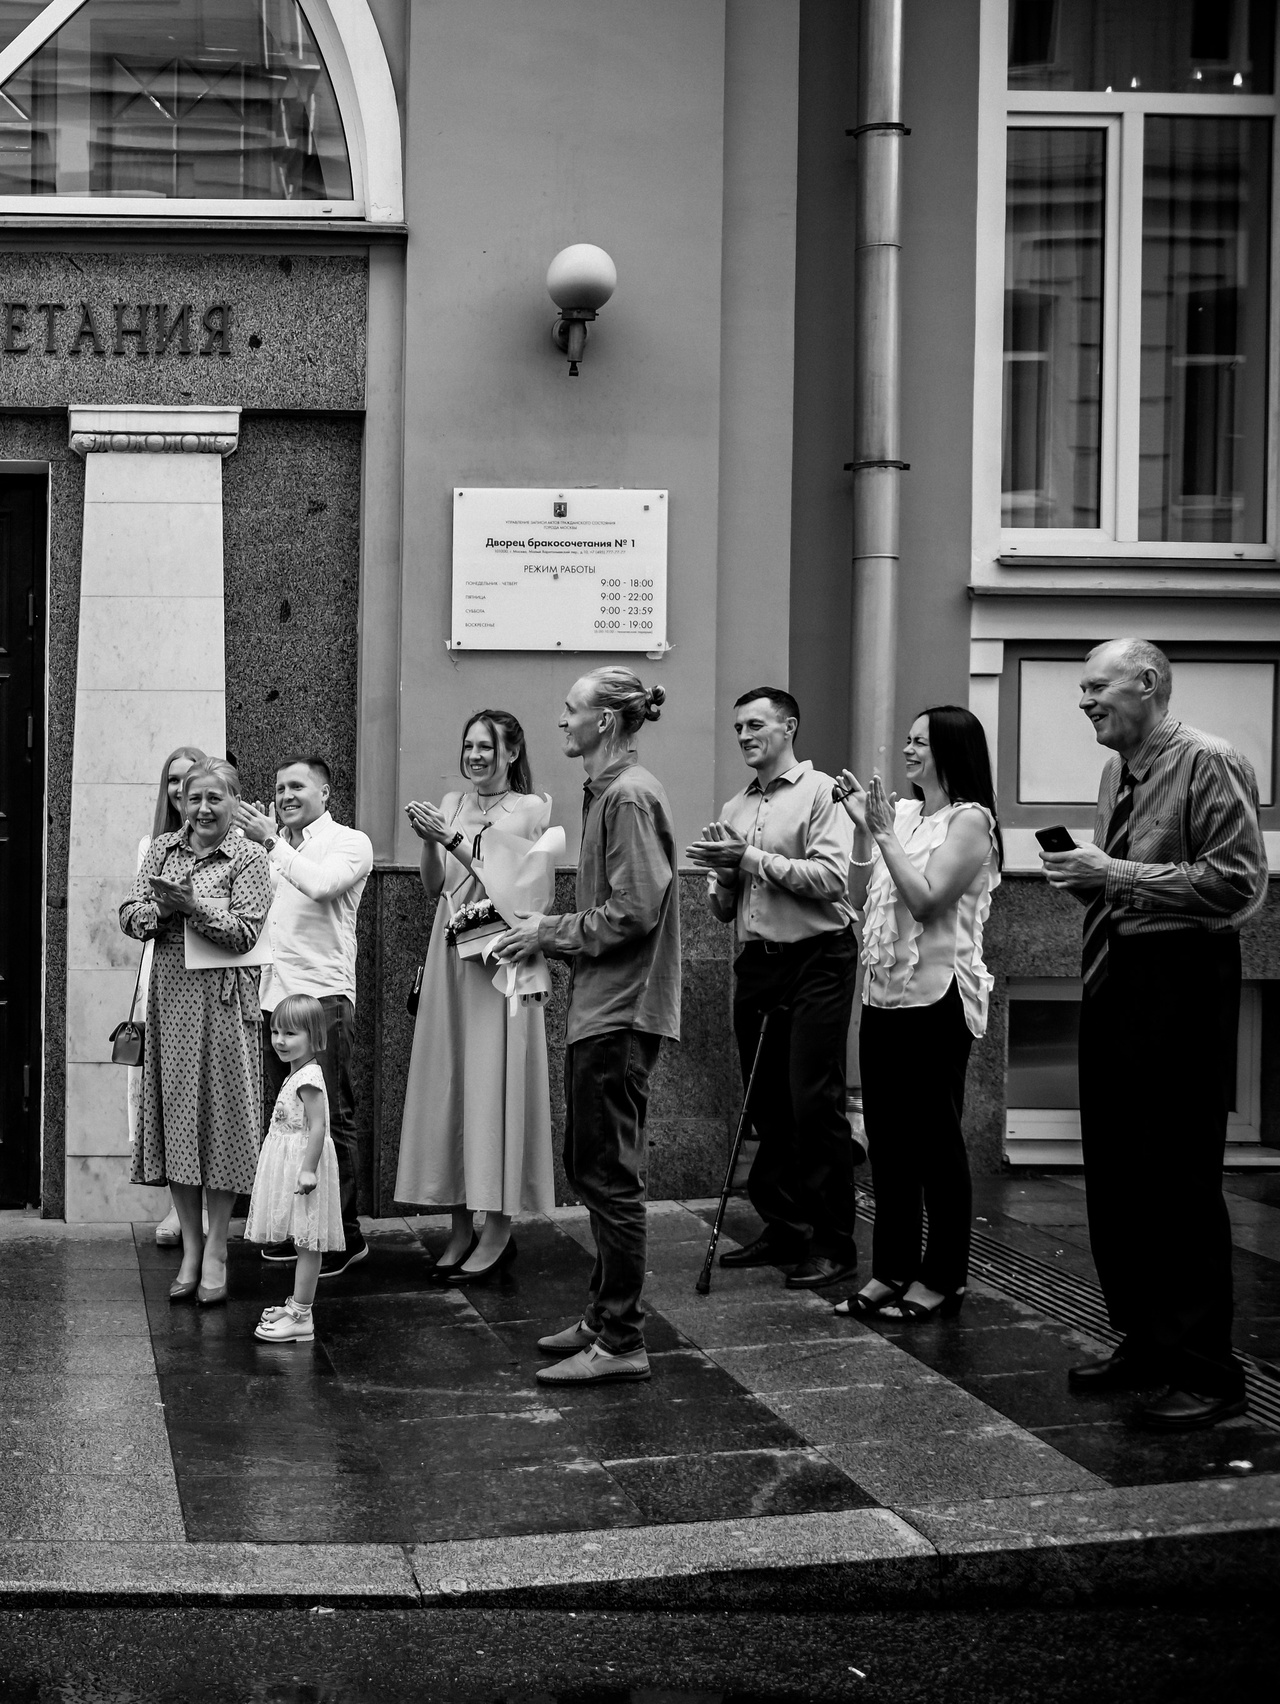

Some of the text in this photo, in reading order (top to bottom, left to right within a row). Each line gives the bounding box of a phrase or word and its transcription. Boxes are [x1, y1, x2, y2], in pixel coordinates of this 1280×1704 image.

[486, 537, 526, 548] Дворец
[528, 538, 612, 549] бракосочетания
[631, 539, 635, 548] 1
[523, 565, 596, 574] РЕЖИМ РАБОТЫ
[601, 579, 620, 587] 9:00
[630, 579, 653, 587] 18:00
[601, 593, 620, 601] 9:00
[628, 593, 653, 601] 22:00
[600, 606, 620, 615] 9:00
[628, 607, 653, 615] 23:59
[594, 620, 620, 629] 00:00
[629, 620, 653, 629] 19:00
